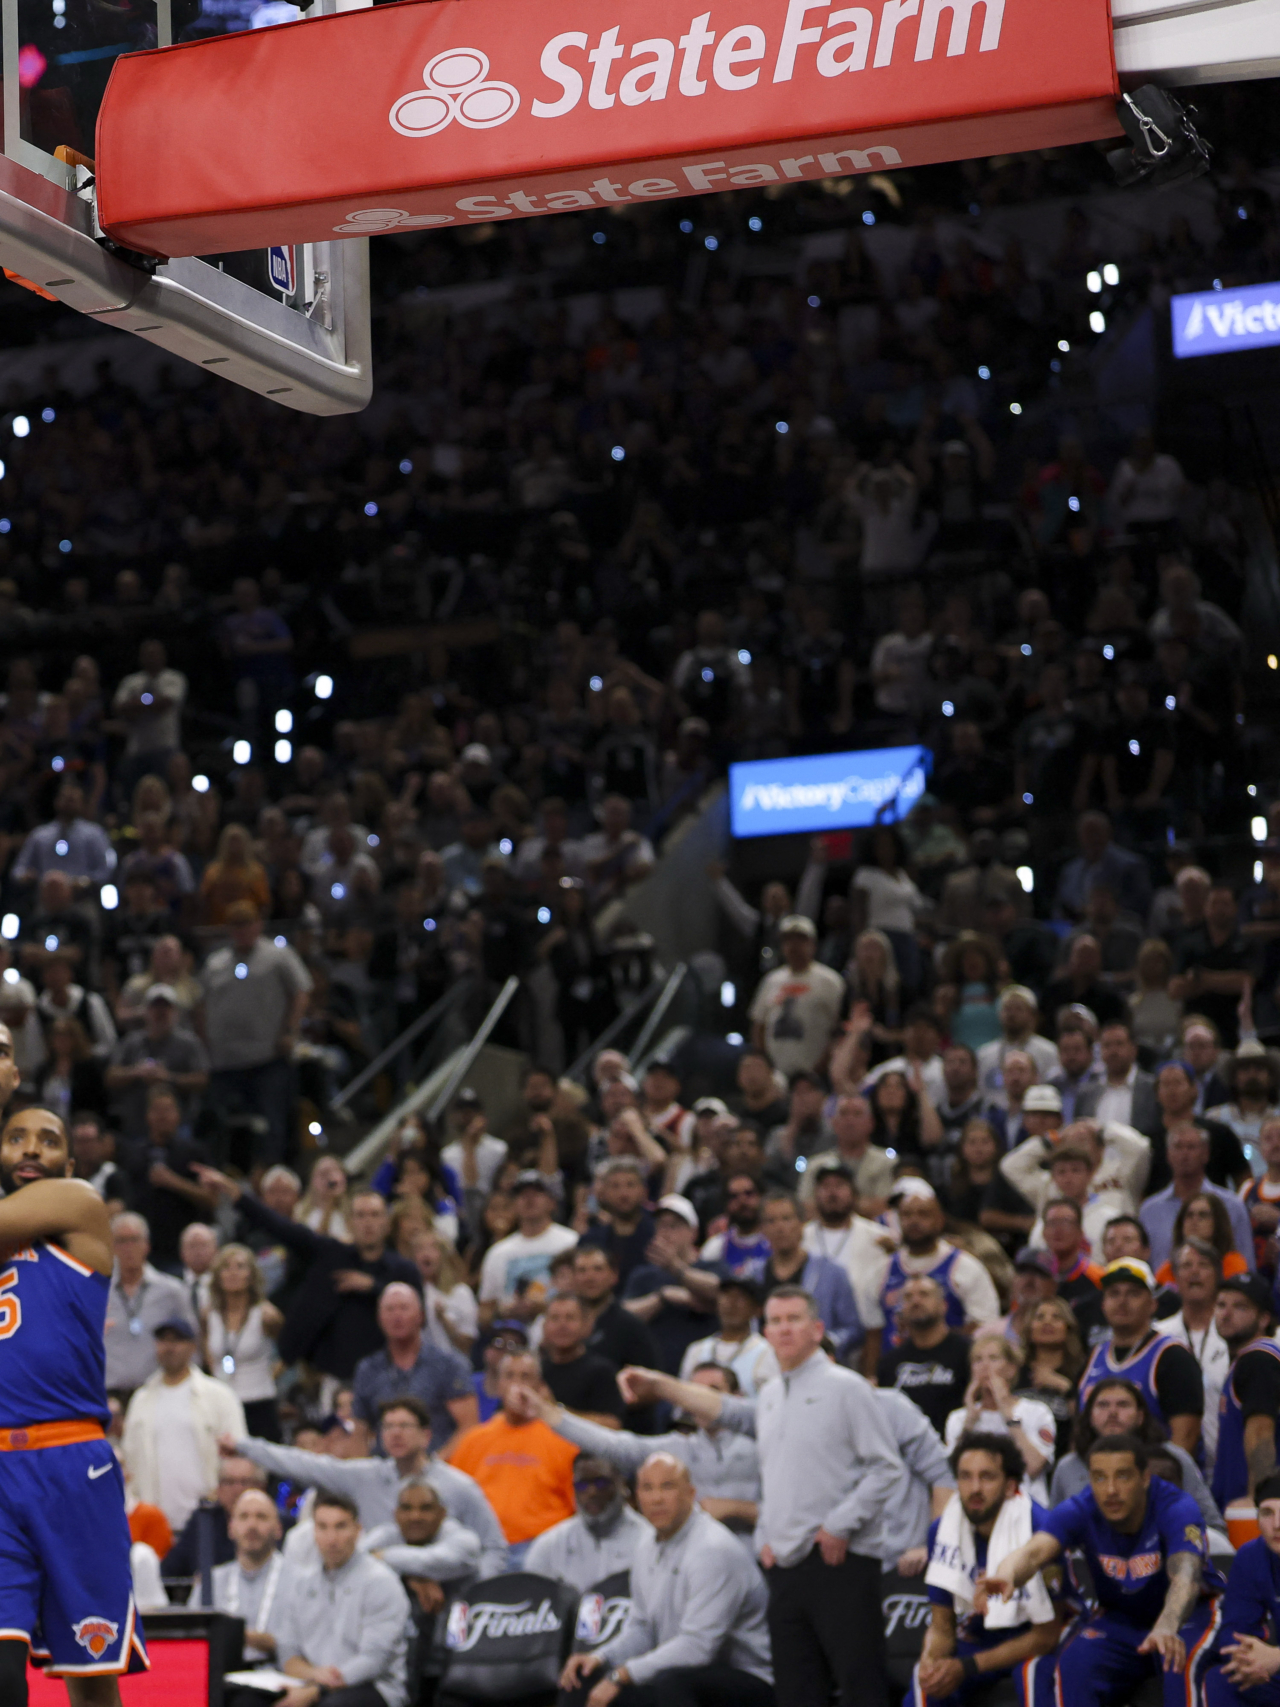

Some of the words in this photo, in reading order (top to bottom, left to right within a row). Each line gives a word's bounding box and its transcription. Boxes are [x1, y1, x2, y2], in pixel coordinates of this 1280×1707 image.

[272, 254, 287, 283] NBA
[1205, 299, 1280, 338] Vict
[453, 1598, 561, 1652] Finals
